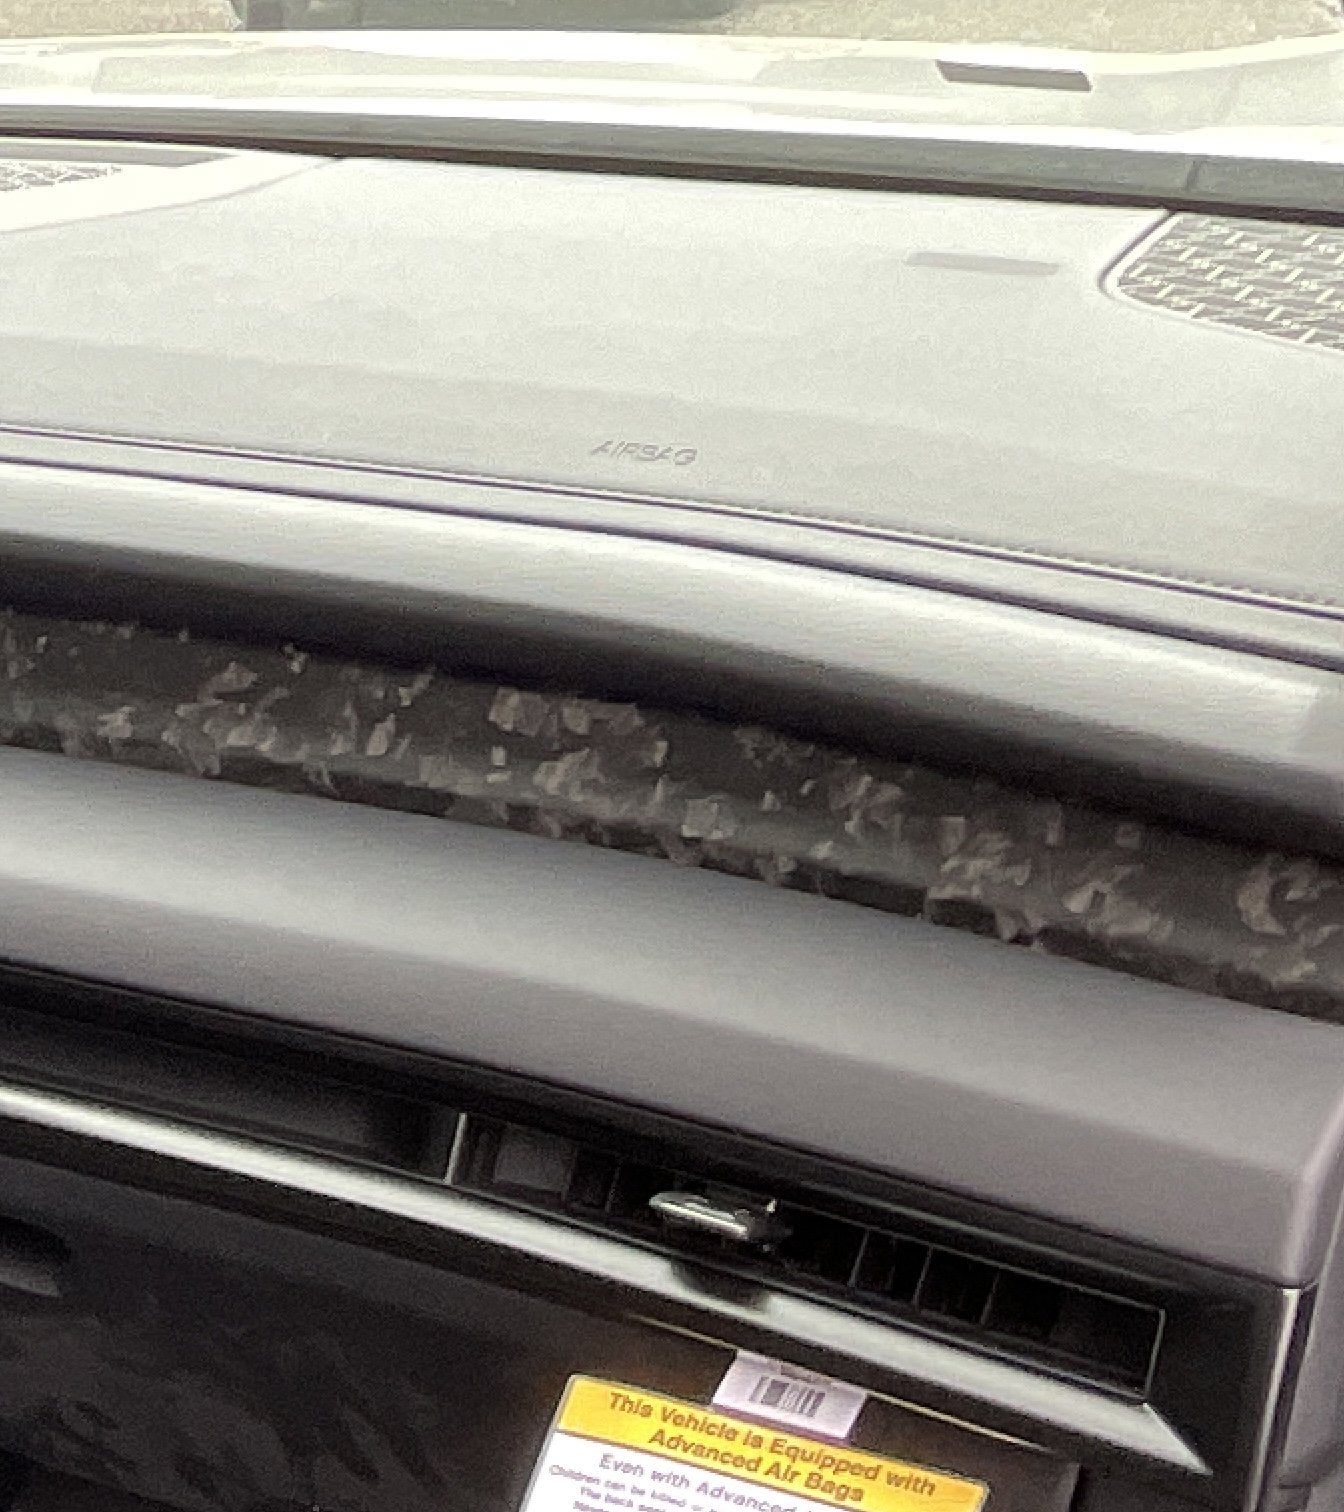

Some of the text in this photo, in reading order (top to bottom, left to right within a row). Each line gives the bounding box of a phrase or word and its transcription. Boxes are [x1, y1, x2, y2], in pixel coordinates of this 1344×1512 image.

[599, 1453, 645, 1477] Even
[651, 1470, 690, 1489] with
[610, 1392, 936, 1496] This Vehicle is Equipped with
[648, 1428, 865, 1501] Advanced Air Bags
